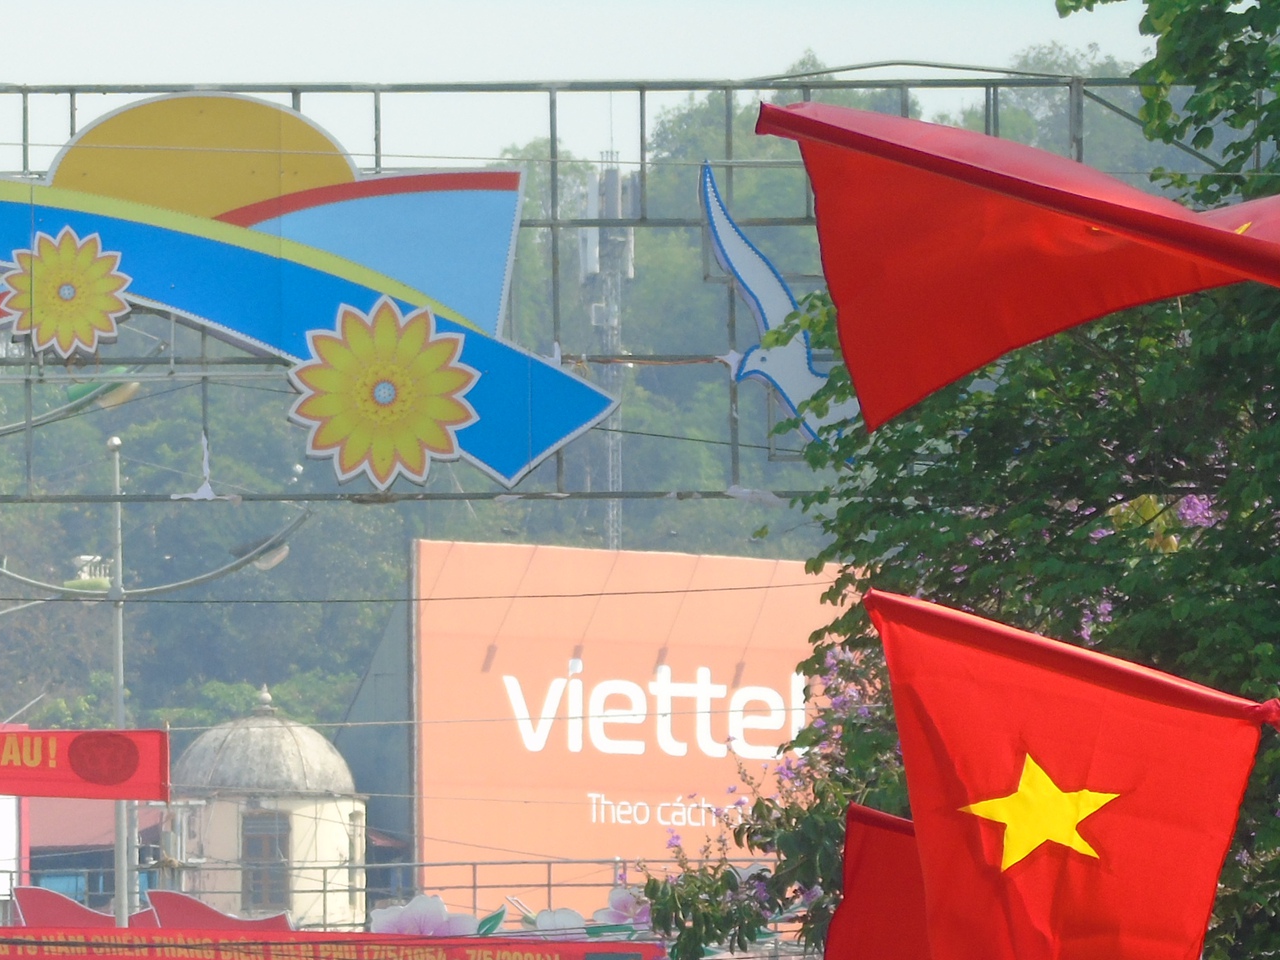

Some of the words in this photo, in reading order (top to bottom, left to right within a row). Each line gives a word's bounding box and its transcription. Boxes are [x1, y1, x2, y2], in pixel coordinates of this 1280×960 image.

[503, 658, 809, 760] viettel
[587, 792, 650, 825] Theo
[657, 795, 716, 827] cách
